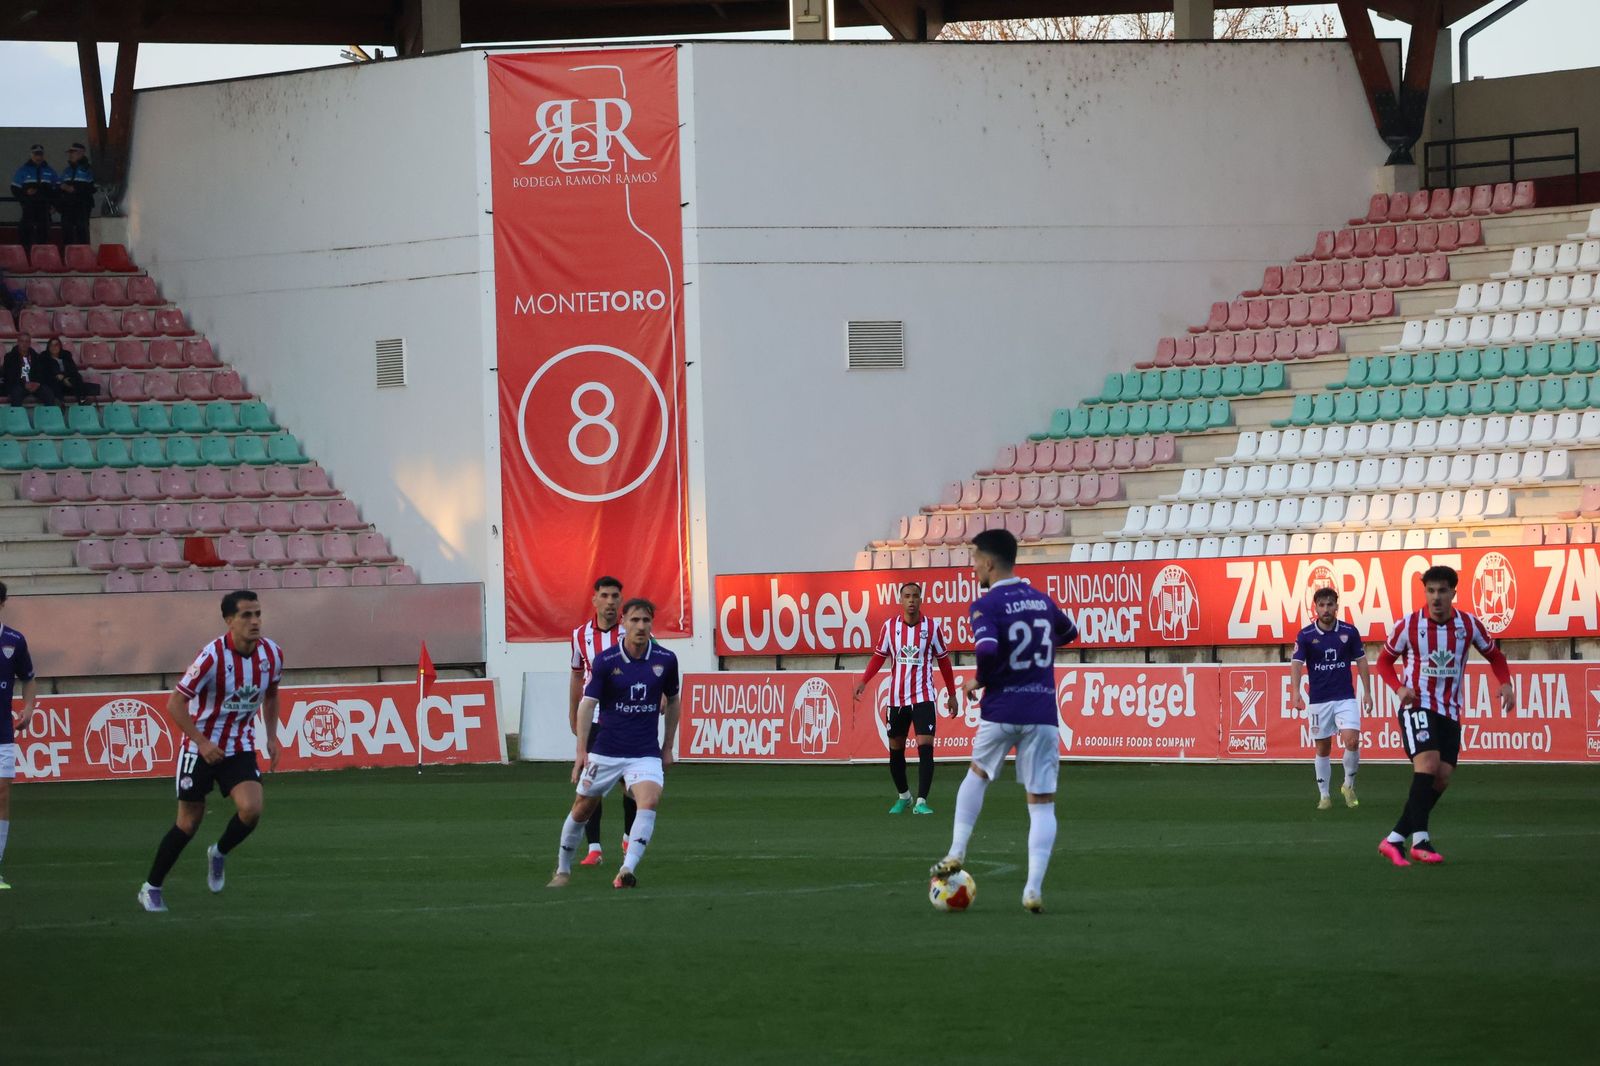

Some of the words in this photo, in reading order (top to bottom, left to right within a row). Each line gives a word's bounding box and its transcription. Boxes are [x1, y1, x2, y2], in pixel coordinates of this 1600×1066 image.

[513, 175, 562, 188] BODEGA
[565, 173, 611, 186] RAMON
[615, 172, 658, 184] RAMOS
[514, 289, 667, 315] MONTETORO
[568, 381, 619, 466] 8
[1047, 566, 1142, 604] FUNDACIÓN
[720, 578, 872, 652] cubiex
[1062, 607, 1142, 644] MORACF
[1009, 619, 1052, 670] 23
[691, 677, 785, 714] FUNDACIÓN
[1080, 672, 1197, 728] Freigel
[1463, 673, 1493, 719] LA
[416, 693, 486, 753] CF
[690, 717, 785, 755] ZAMORACF
[1311, 714, 1320, 727] 11
[1411, 711, 1429, 730] 19
[1460, 723, 1552, 752] (Zamora)
[943, 737, 968, 747] FOODS
[1076, 736, 1082, 746] A
[1085, 736, 1124, 746] GOODLIFE
[1126, 736, 1153, 747] FOODS
[1155, 736, 1196, 748] COMPANY
[183, 751, 198, 774] 17
